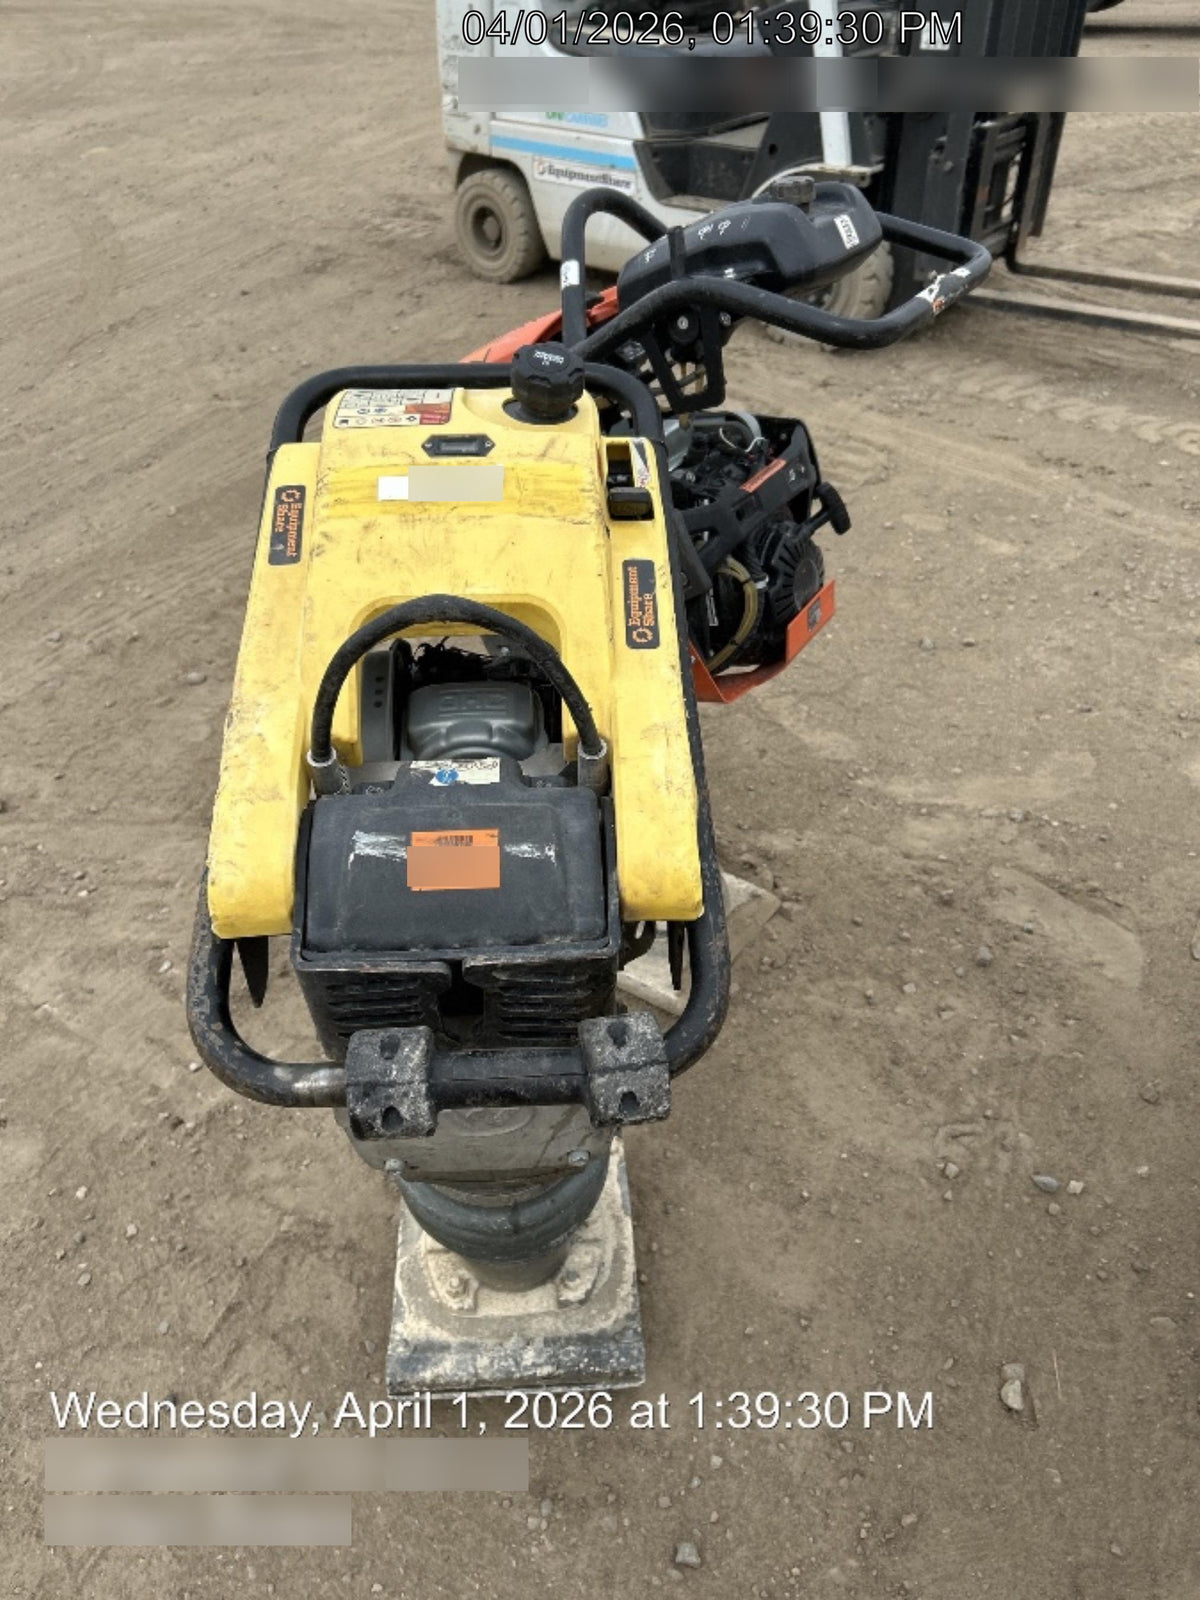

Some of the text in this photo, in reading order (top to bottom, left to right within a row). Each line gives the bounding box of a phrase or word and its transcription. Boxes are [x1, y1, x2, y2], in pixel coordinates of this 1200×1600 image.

[275, 503, 289, 533] Share
[286, 502, 303, 558] Equipment
[627, 566, 643, 627] Equipment
[642, 592, 656, 627] Share
